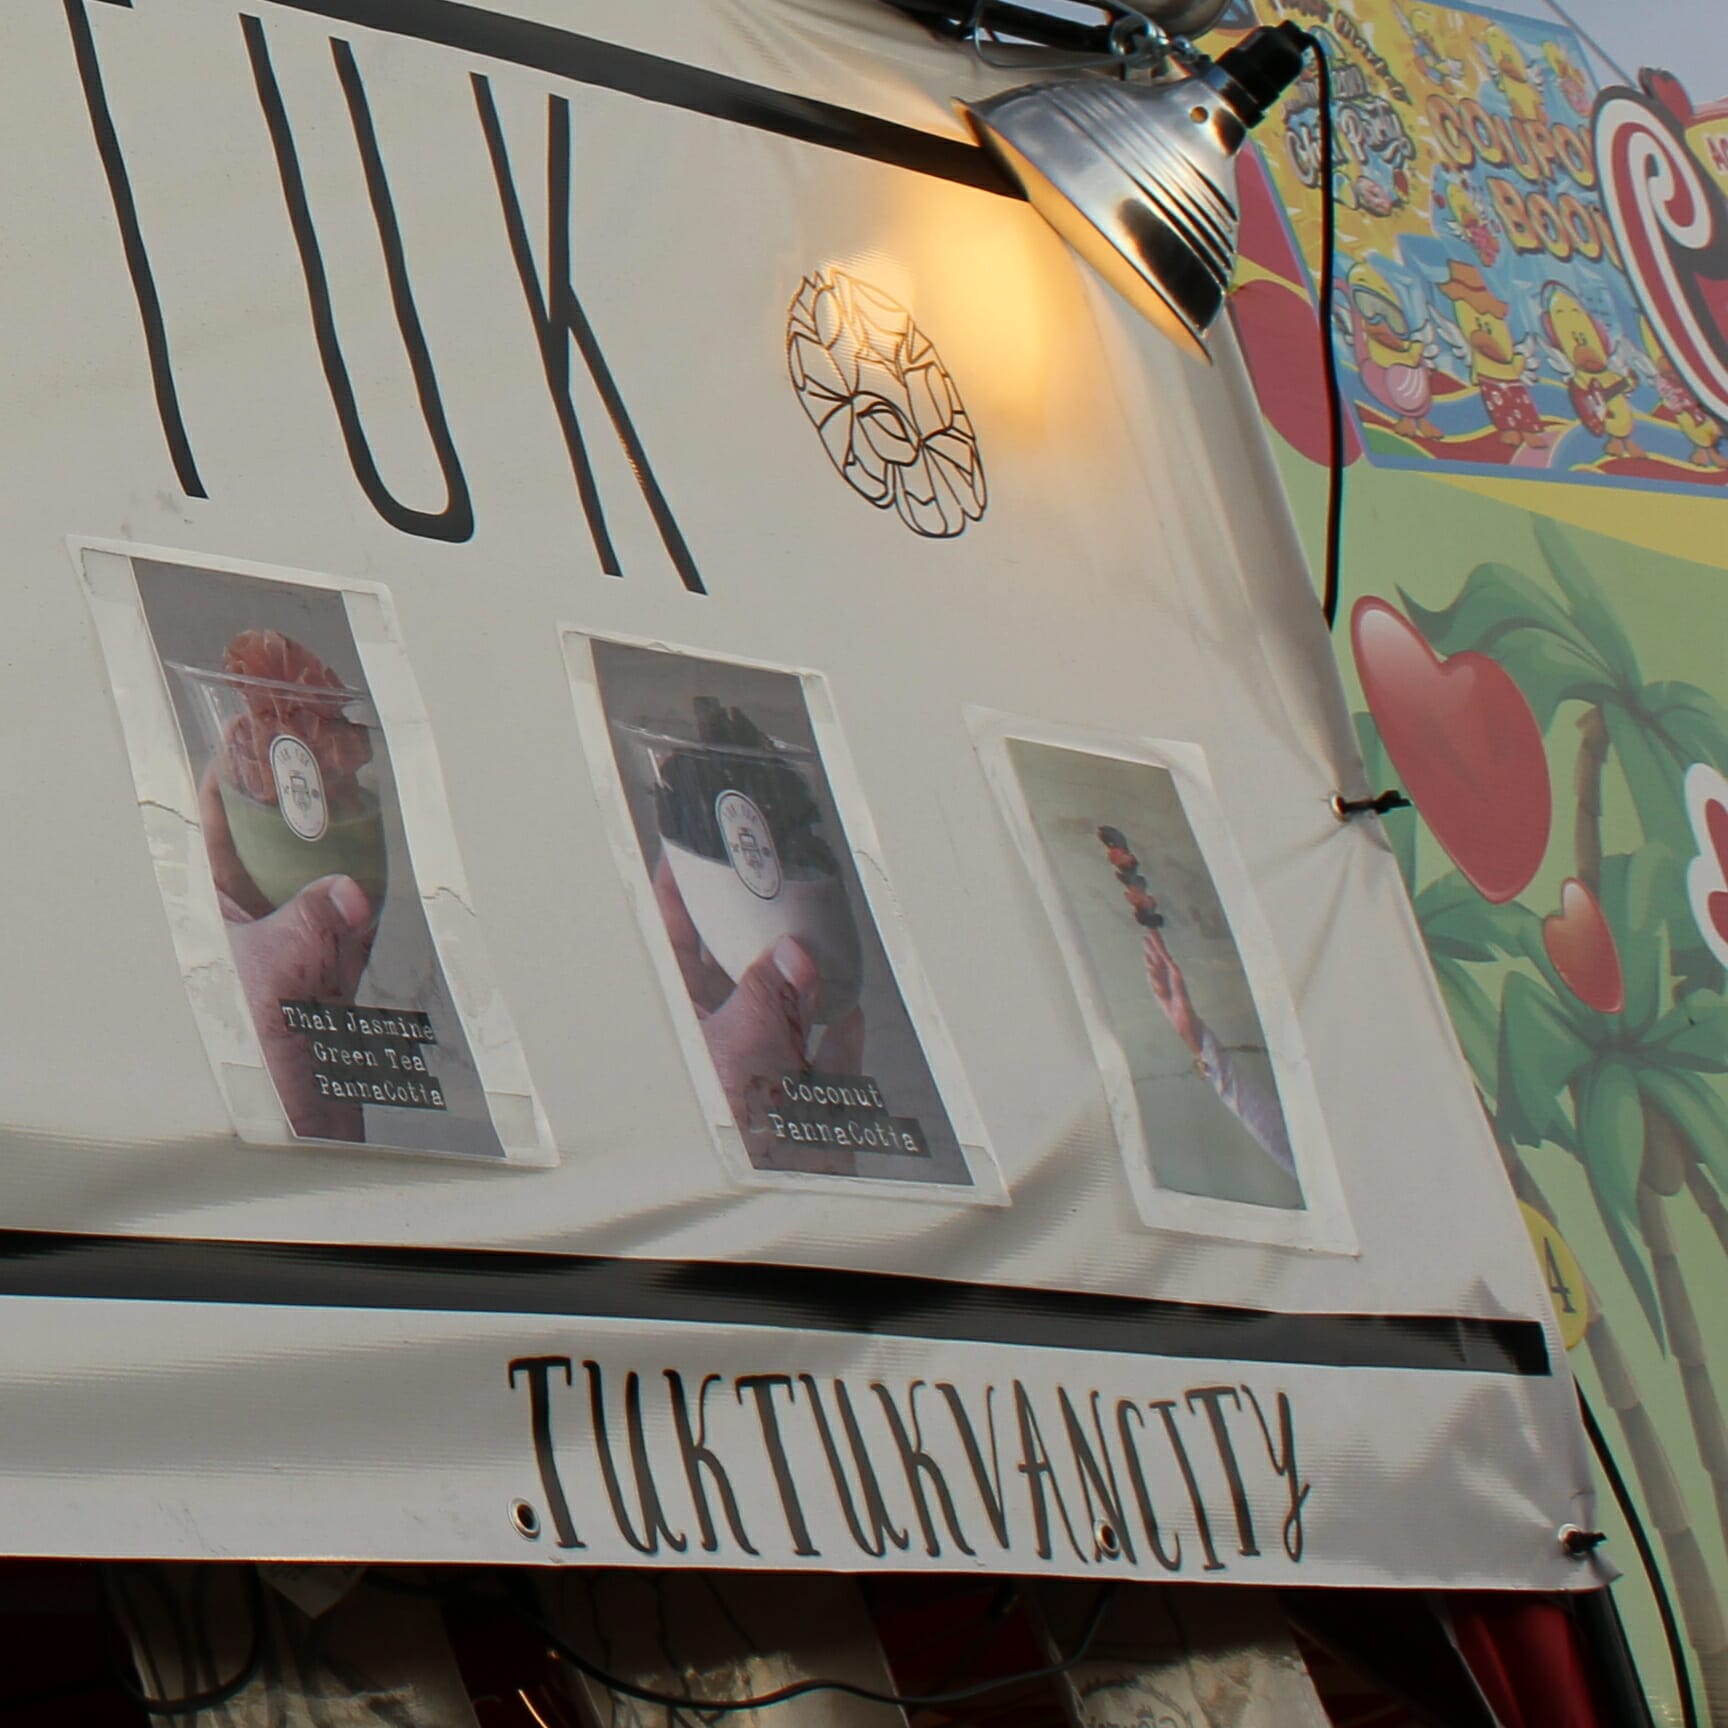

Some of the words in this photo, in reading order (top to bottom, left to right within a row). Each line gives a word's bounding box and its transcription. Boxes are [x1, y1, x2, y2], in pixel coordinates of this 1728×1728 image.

[282, 1005, 338, 1032] Thai
[346, 1010, 435, 1041] Jasmine
[313, 1041, 379, 1068] Green
[384, 1048, 427, 1072] Tea
[315, 1074, 445, 1107] PannaCotta
[782, 1075, 885, 1109] Coconut
[768, 1113, 920, 1153] PannaCotta
[508, 1354, 1311, 1573] TUKTUKVANCITY
